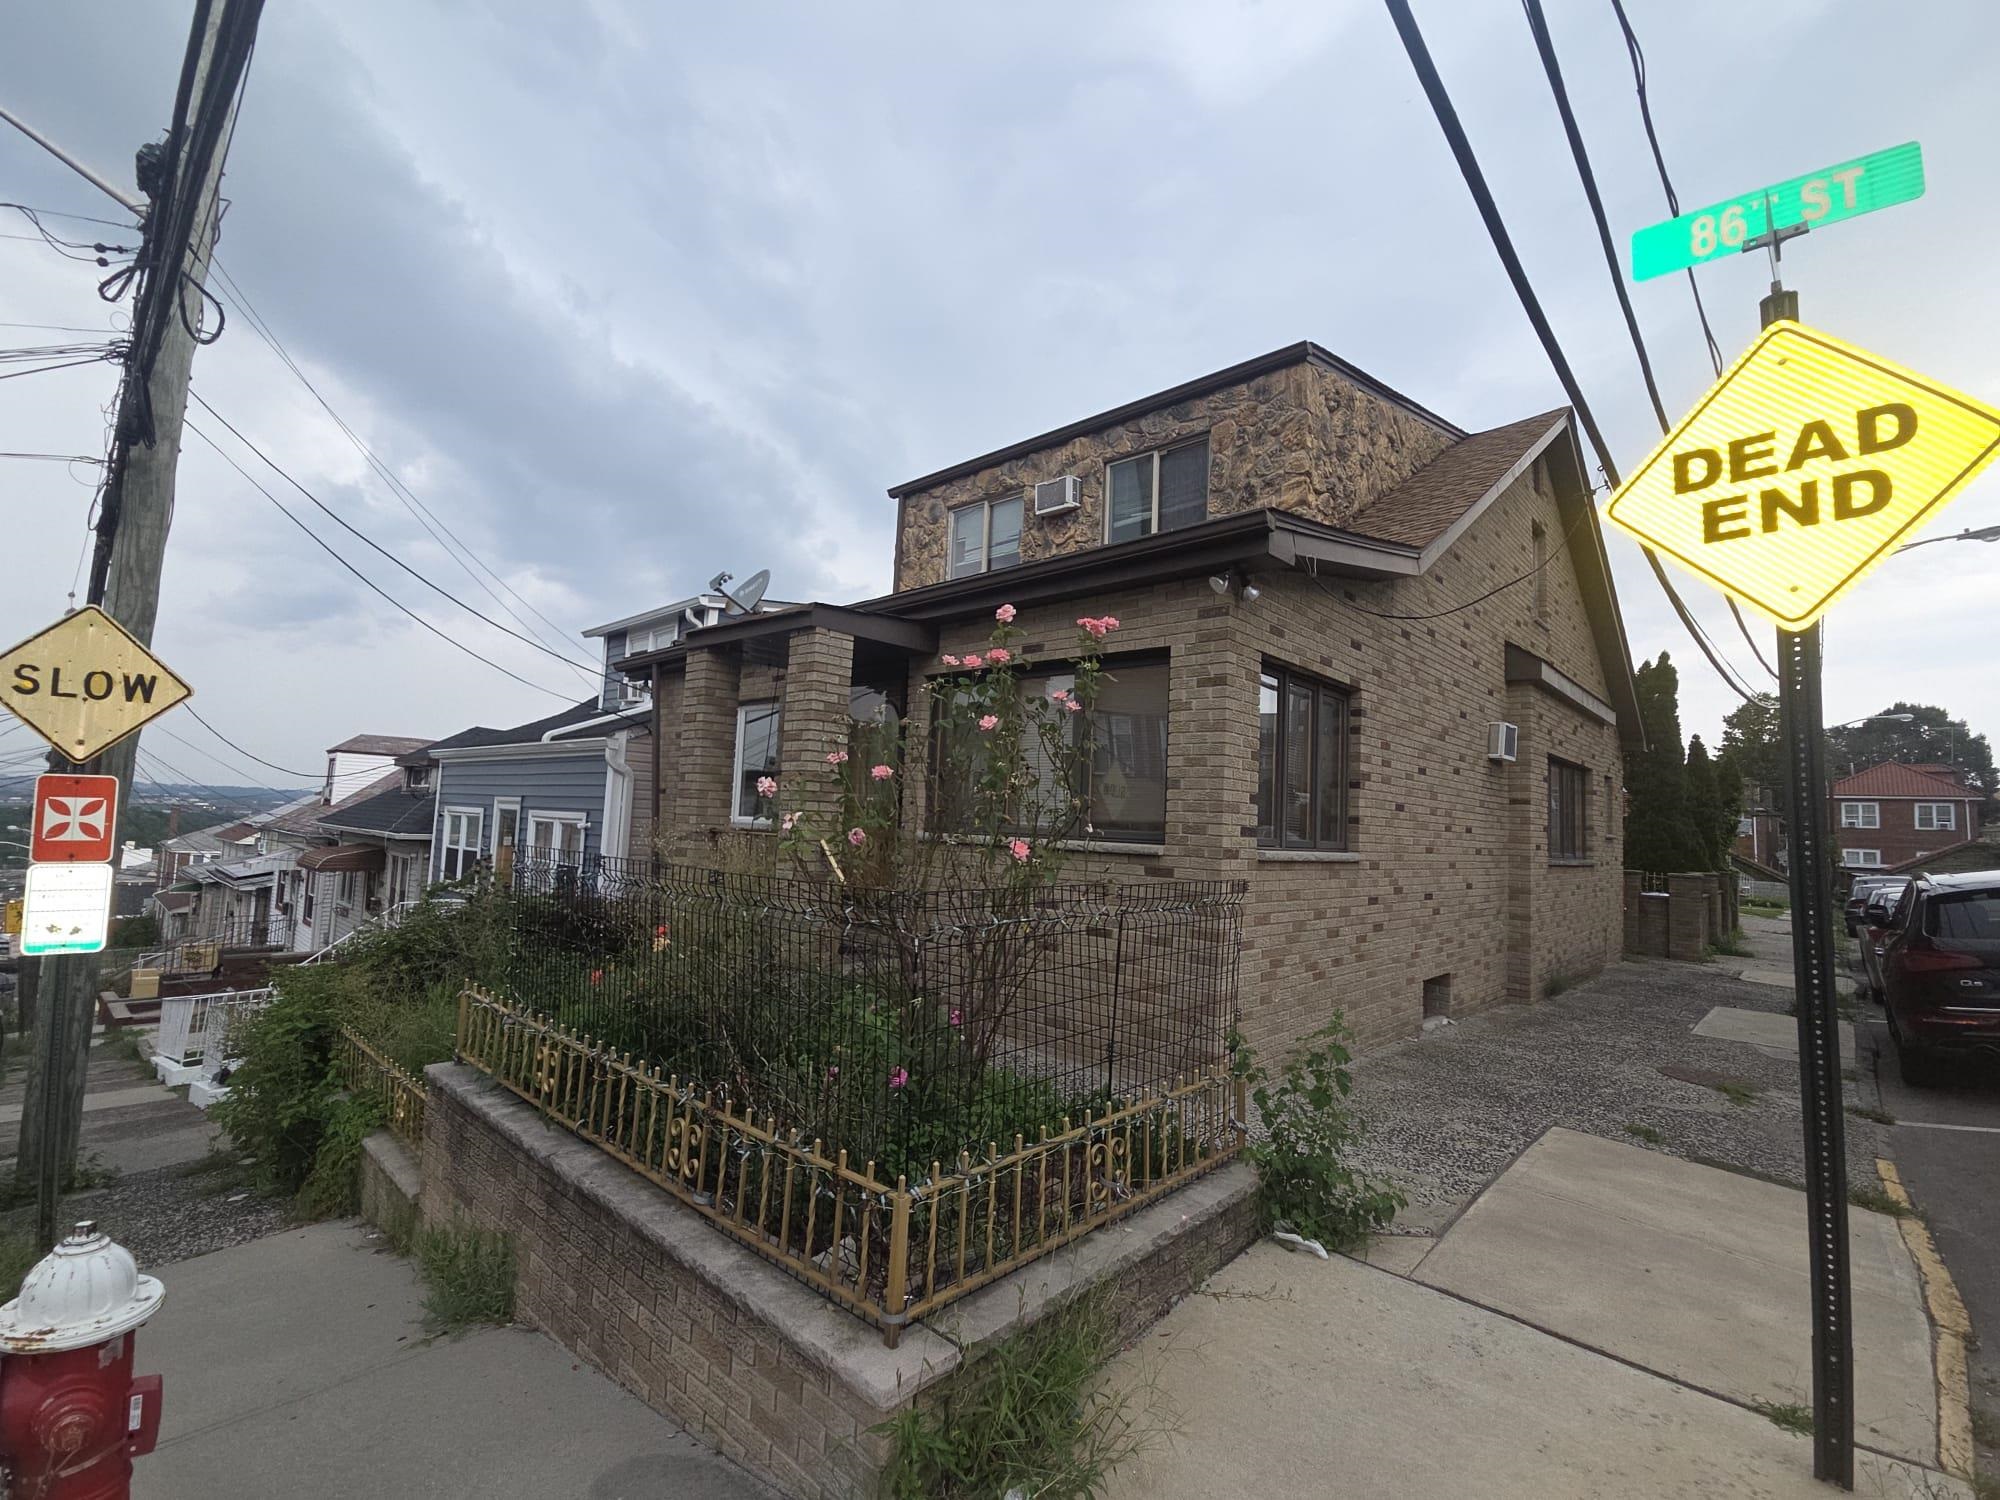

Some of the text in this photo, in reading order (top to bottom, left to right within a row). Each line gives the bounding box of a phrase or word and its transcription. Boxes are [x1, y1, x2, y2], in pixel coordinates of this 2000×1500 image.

[1800, 166, 1865, 222] ST
[1673, 402, 1918, 495] DEAD
[1702, 469, 1893, 544] END
[11, 664, 157, 703] SLOW
